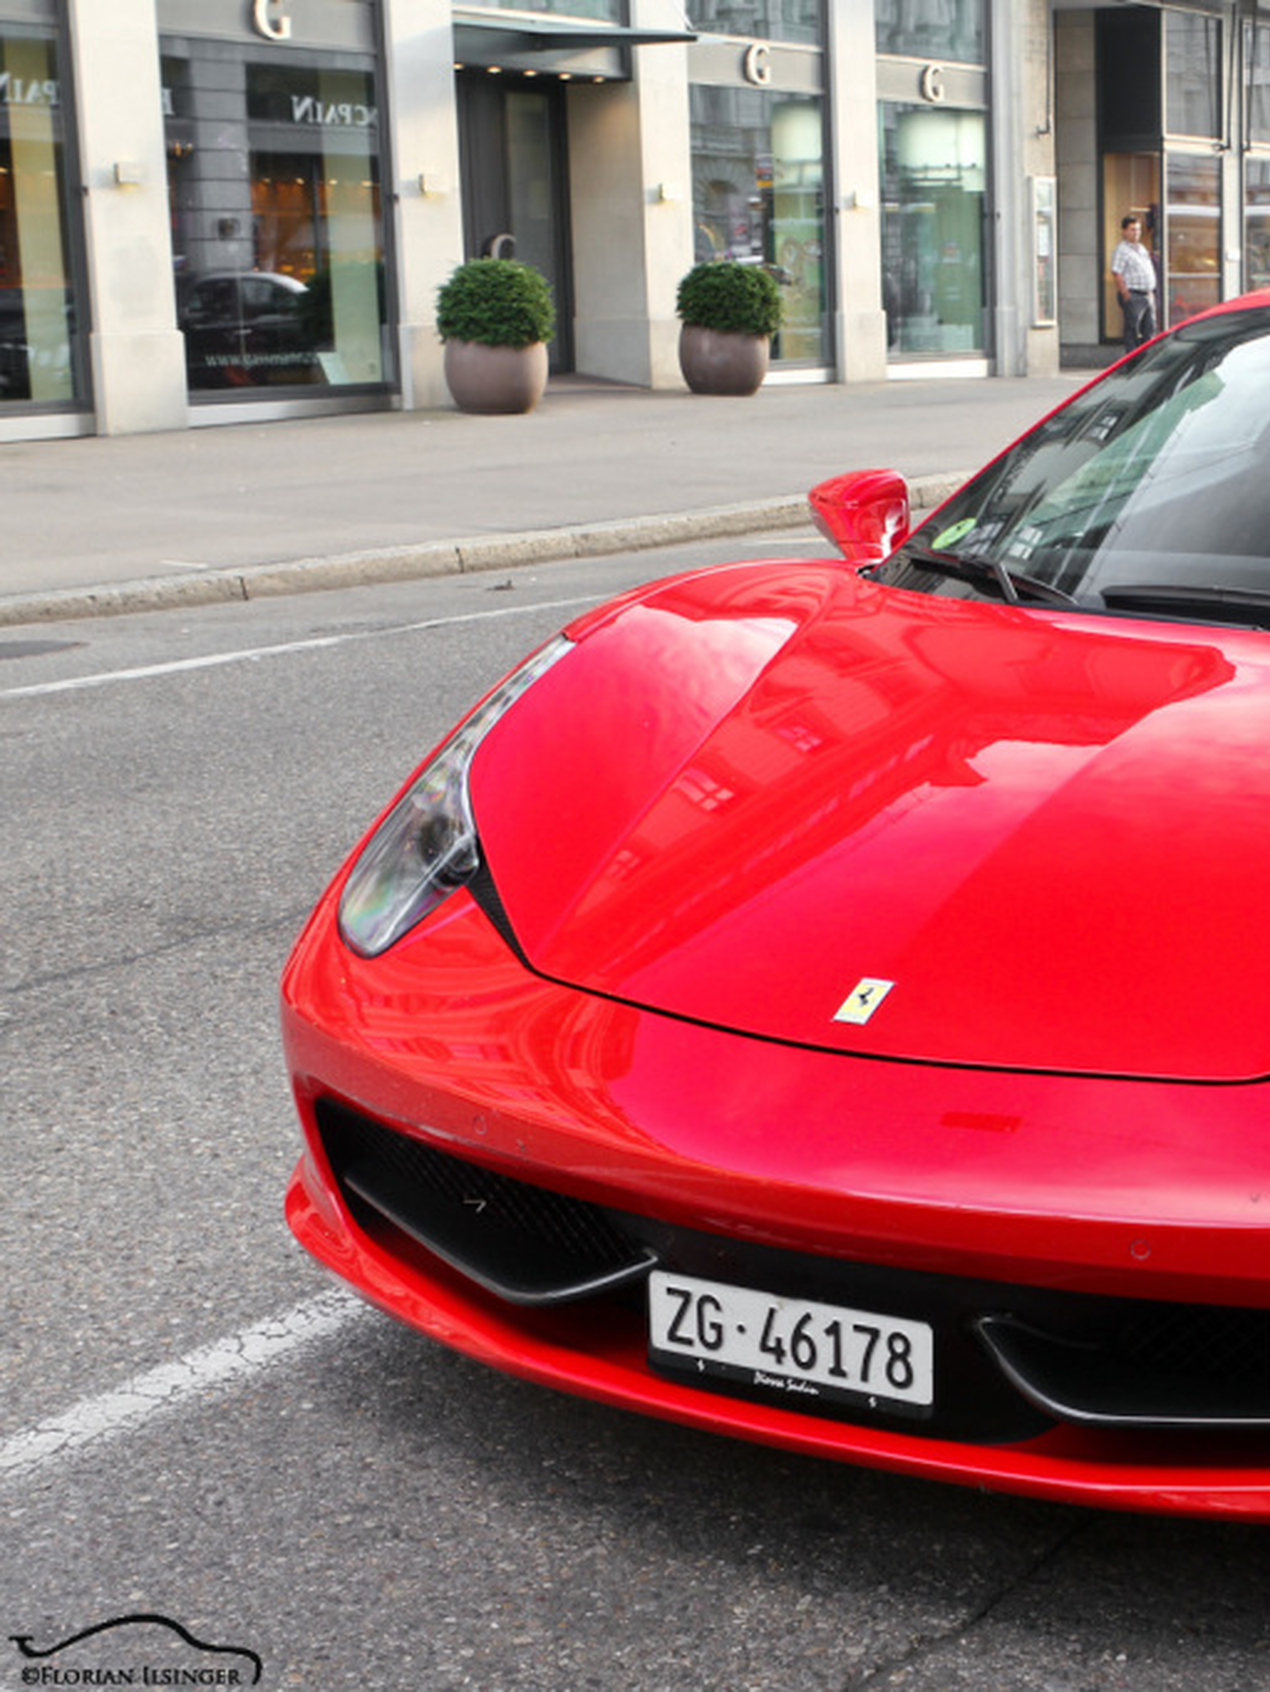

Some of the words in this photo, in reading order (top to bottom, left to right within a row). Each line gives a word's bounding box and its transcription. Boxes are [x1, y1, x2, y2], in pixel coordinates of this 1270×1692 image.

[254, 0, 292, 41] G
[745, 44, 771, 85] G
[922, 65, 945, 102] G
